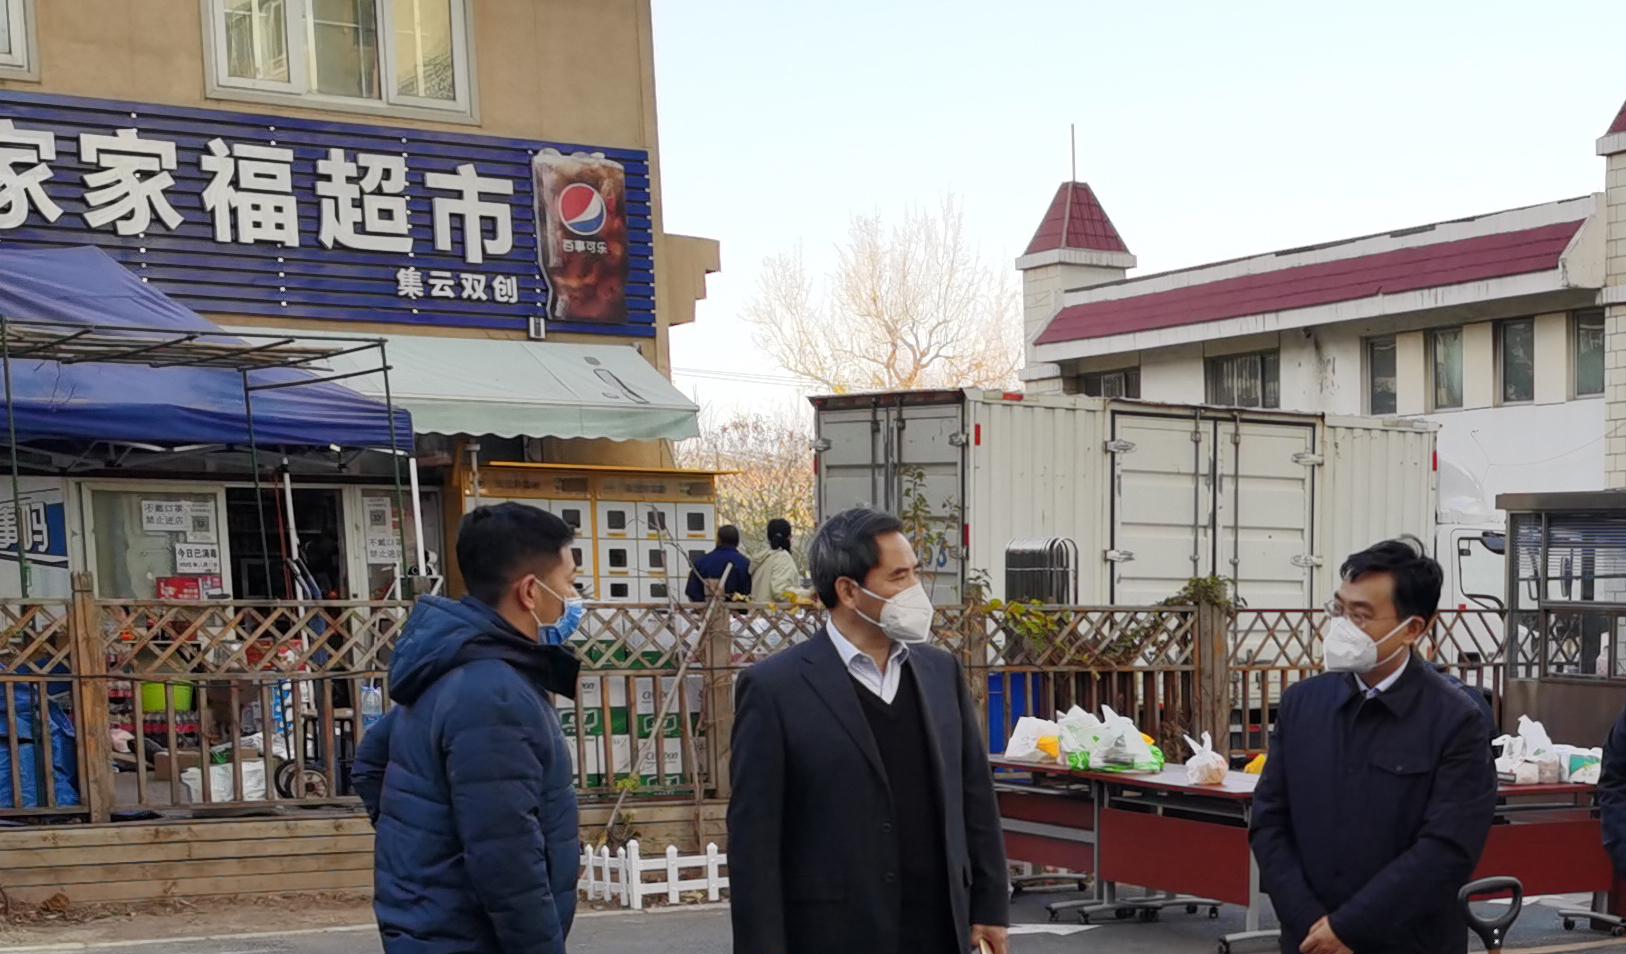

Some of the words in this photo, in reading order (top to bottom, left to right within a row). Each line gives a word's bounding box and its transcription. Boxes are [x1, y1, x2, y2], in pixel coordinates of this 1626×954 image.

[0, 118, 515, 264] 家家福超市
[562, 239, 608, 254] 百事可乐
[397, 267, 519, 304] 集云双创
